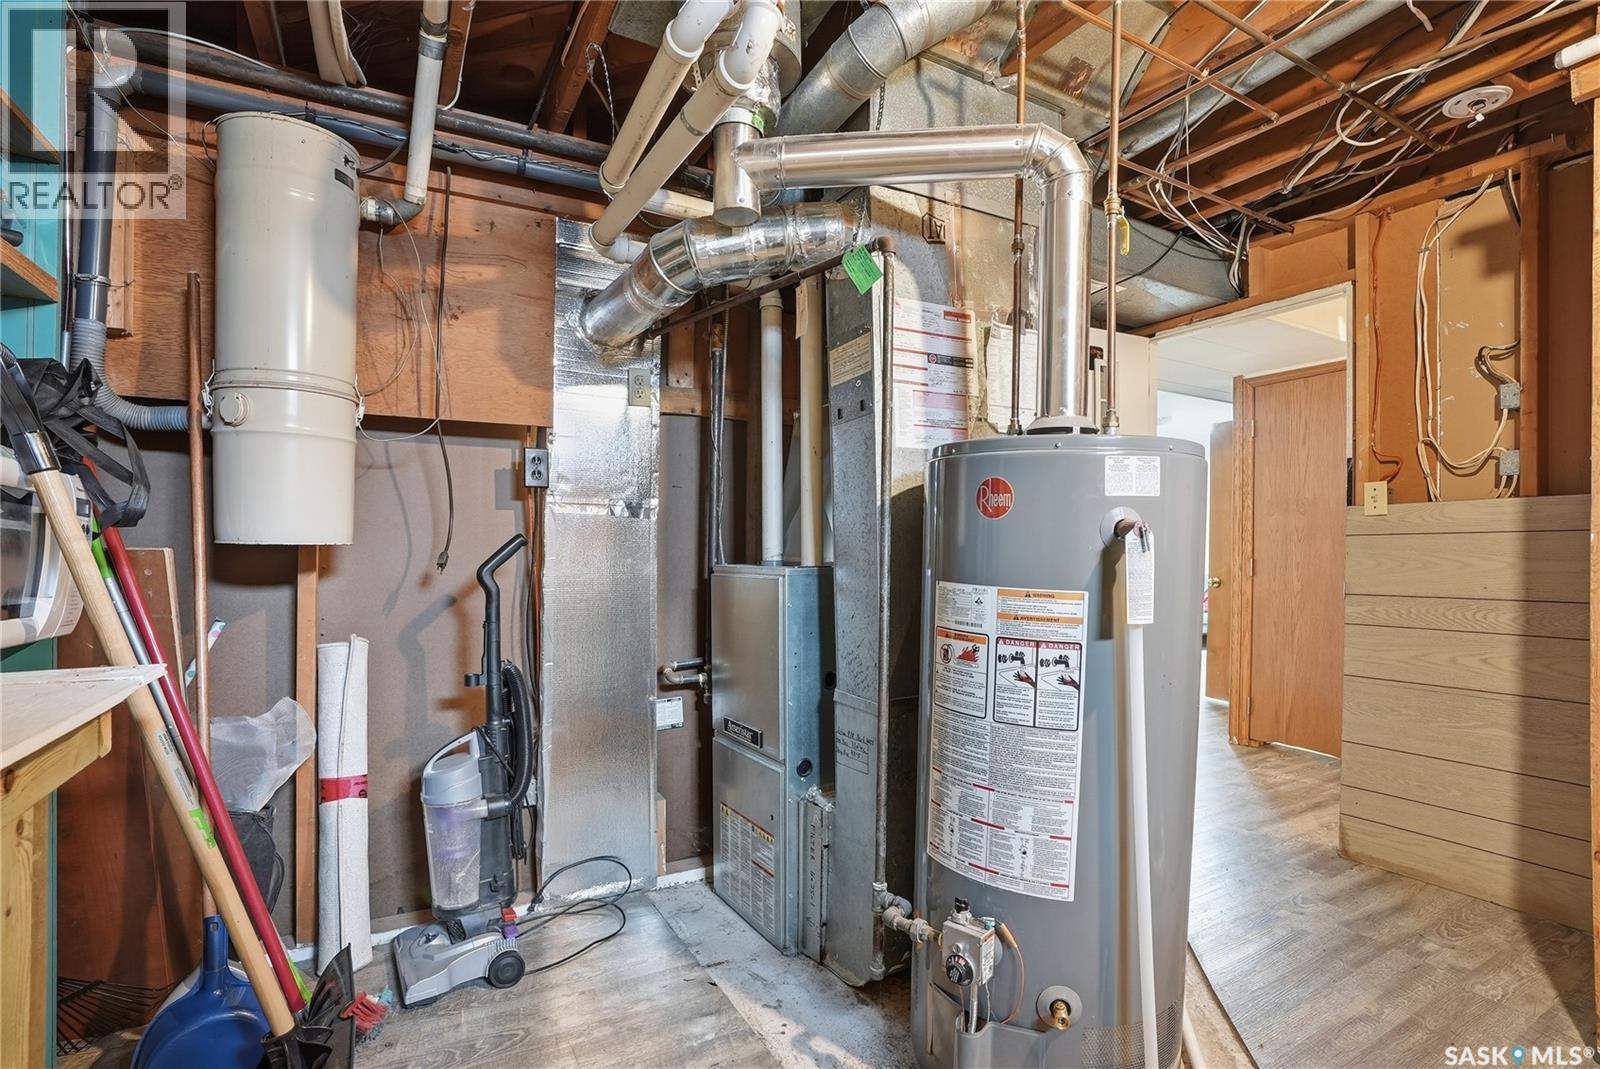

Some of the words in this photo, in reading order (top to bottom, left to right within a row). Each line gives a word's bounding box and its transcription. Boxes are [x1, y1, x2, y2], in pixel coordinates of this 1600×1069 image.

[979, 478, 1012, 512] Rheem
[1020, 614, 1060, 623] AVERTISSEMENT
[1006, 639, 1036, 648] DANGER
[727, 720, 754, 739] Ameristar
